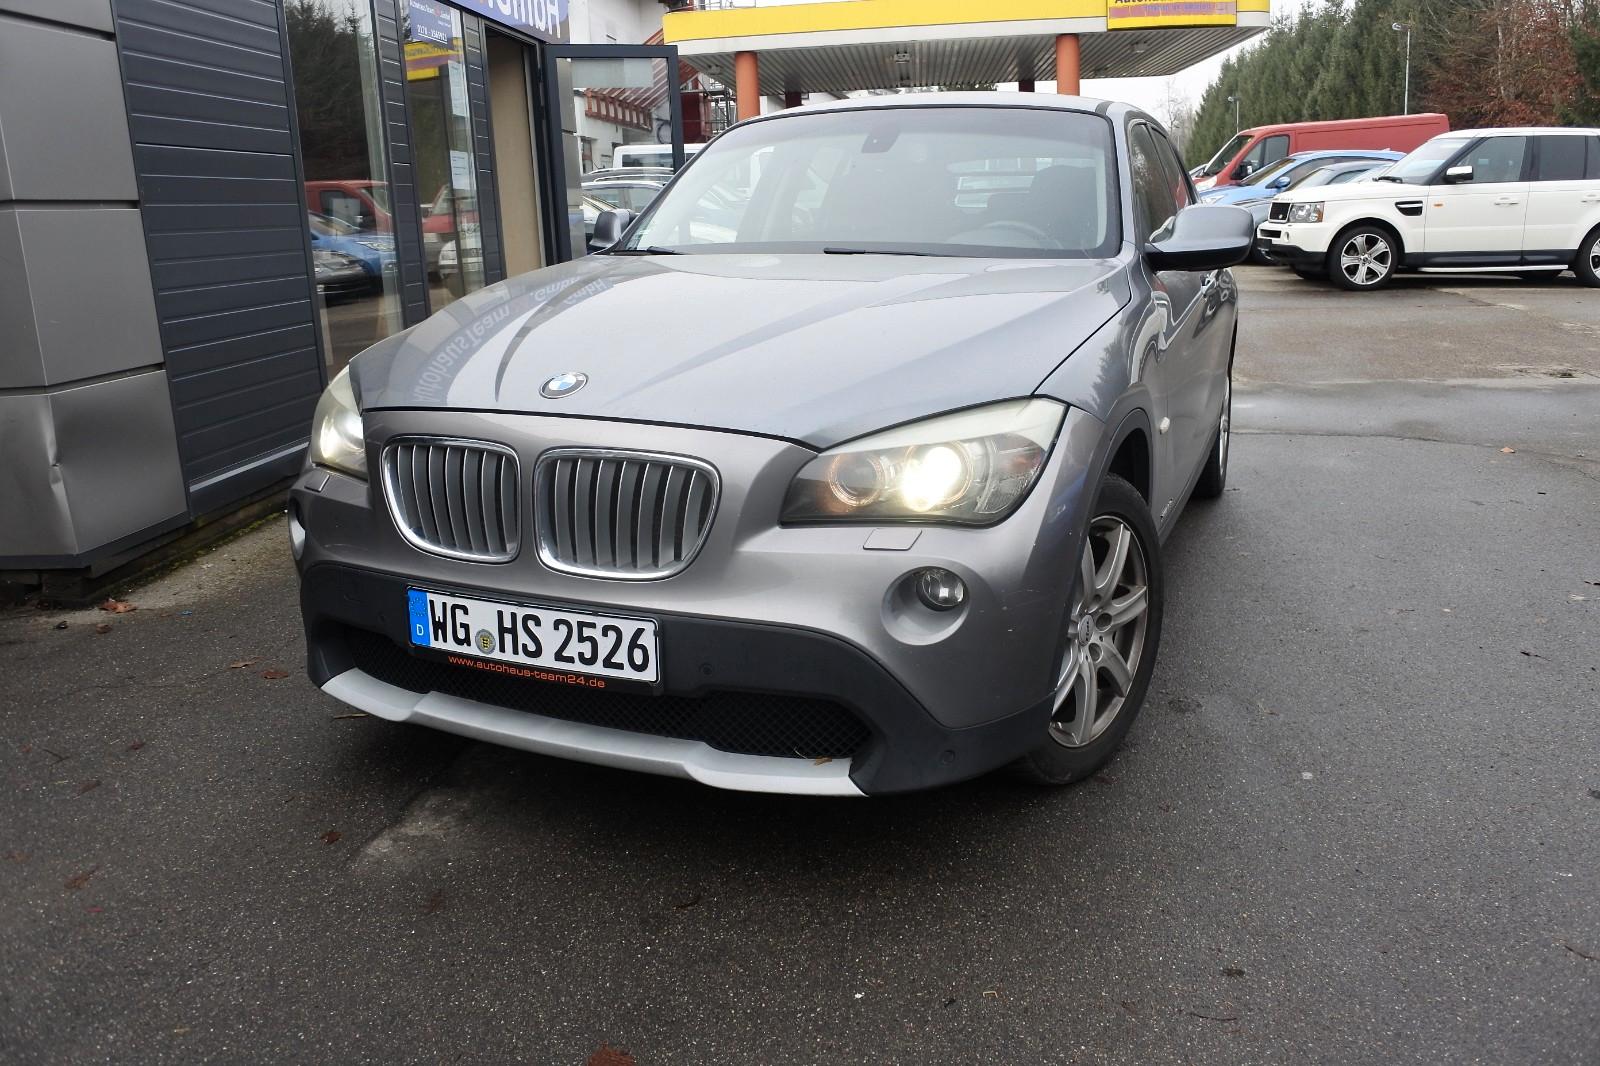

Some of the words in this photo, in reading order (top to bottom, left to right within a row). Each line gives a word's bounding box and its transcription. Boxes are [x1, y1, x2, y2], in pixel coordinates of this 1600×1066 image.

[416, 624, 424, 635] D
[429, 599, 471, 646] WG
[497, 609, 542, 658] HS
[553, 618, 650, 672] 2526
[448, 656, 606, 688] www.autohaus-team24.de
